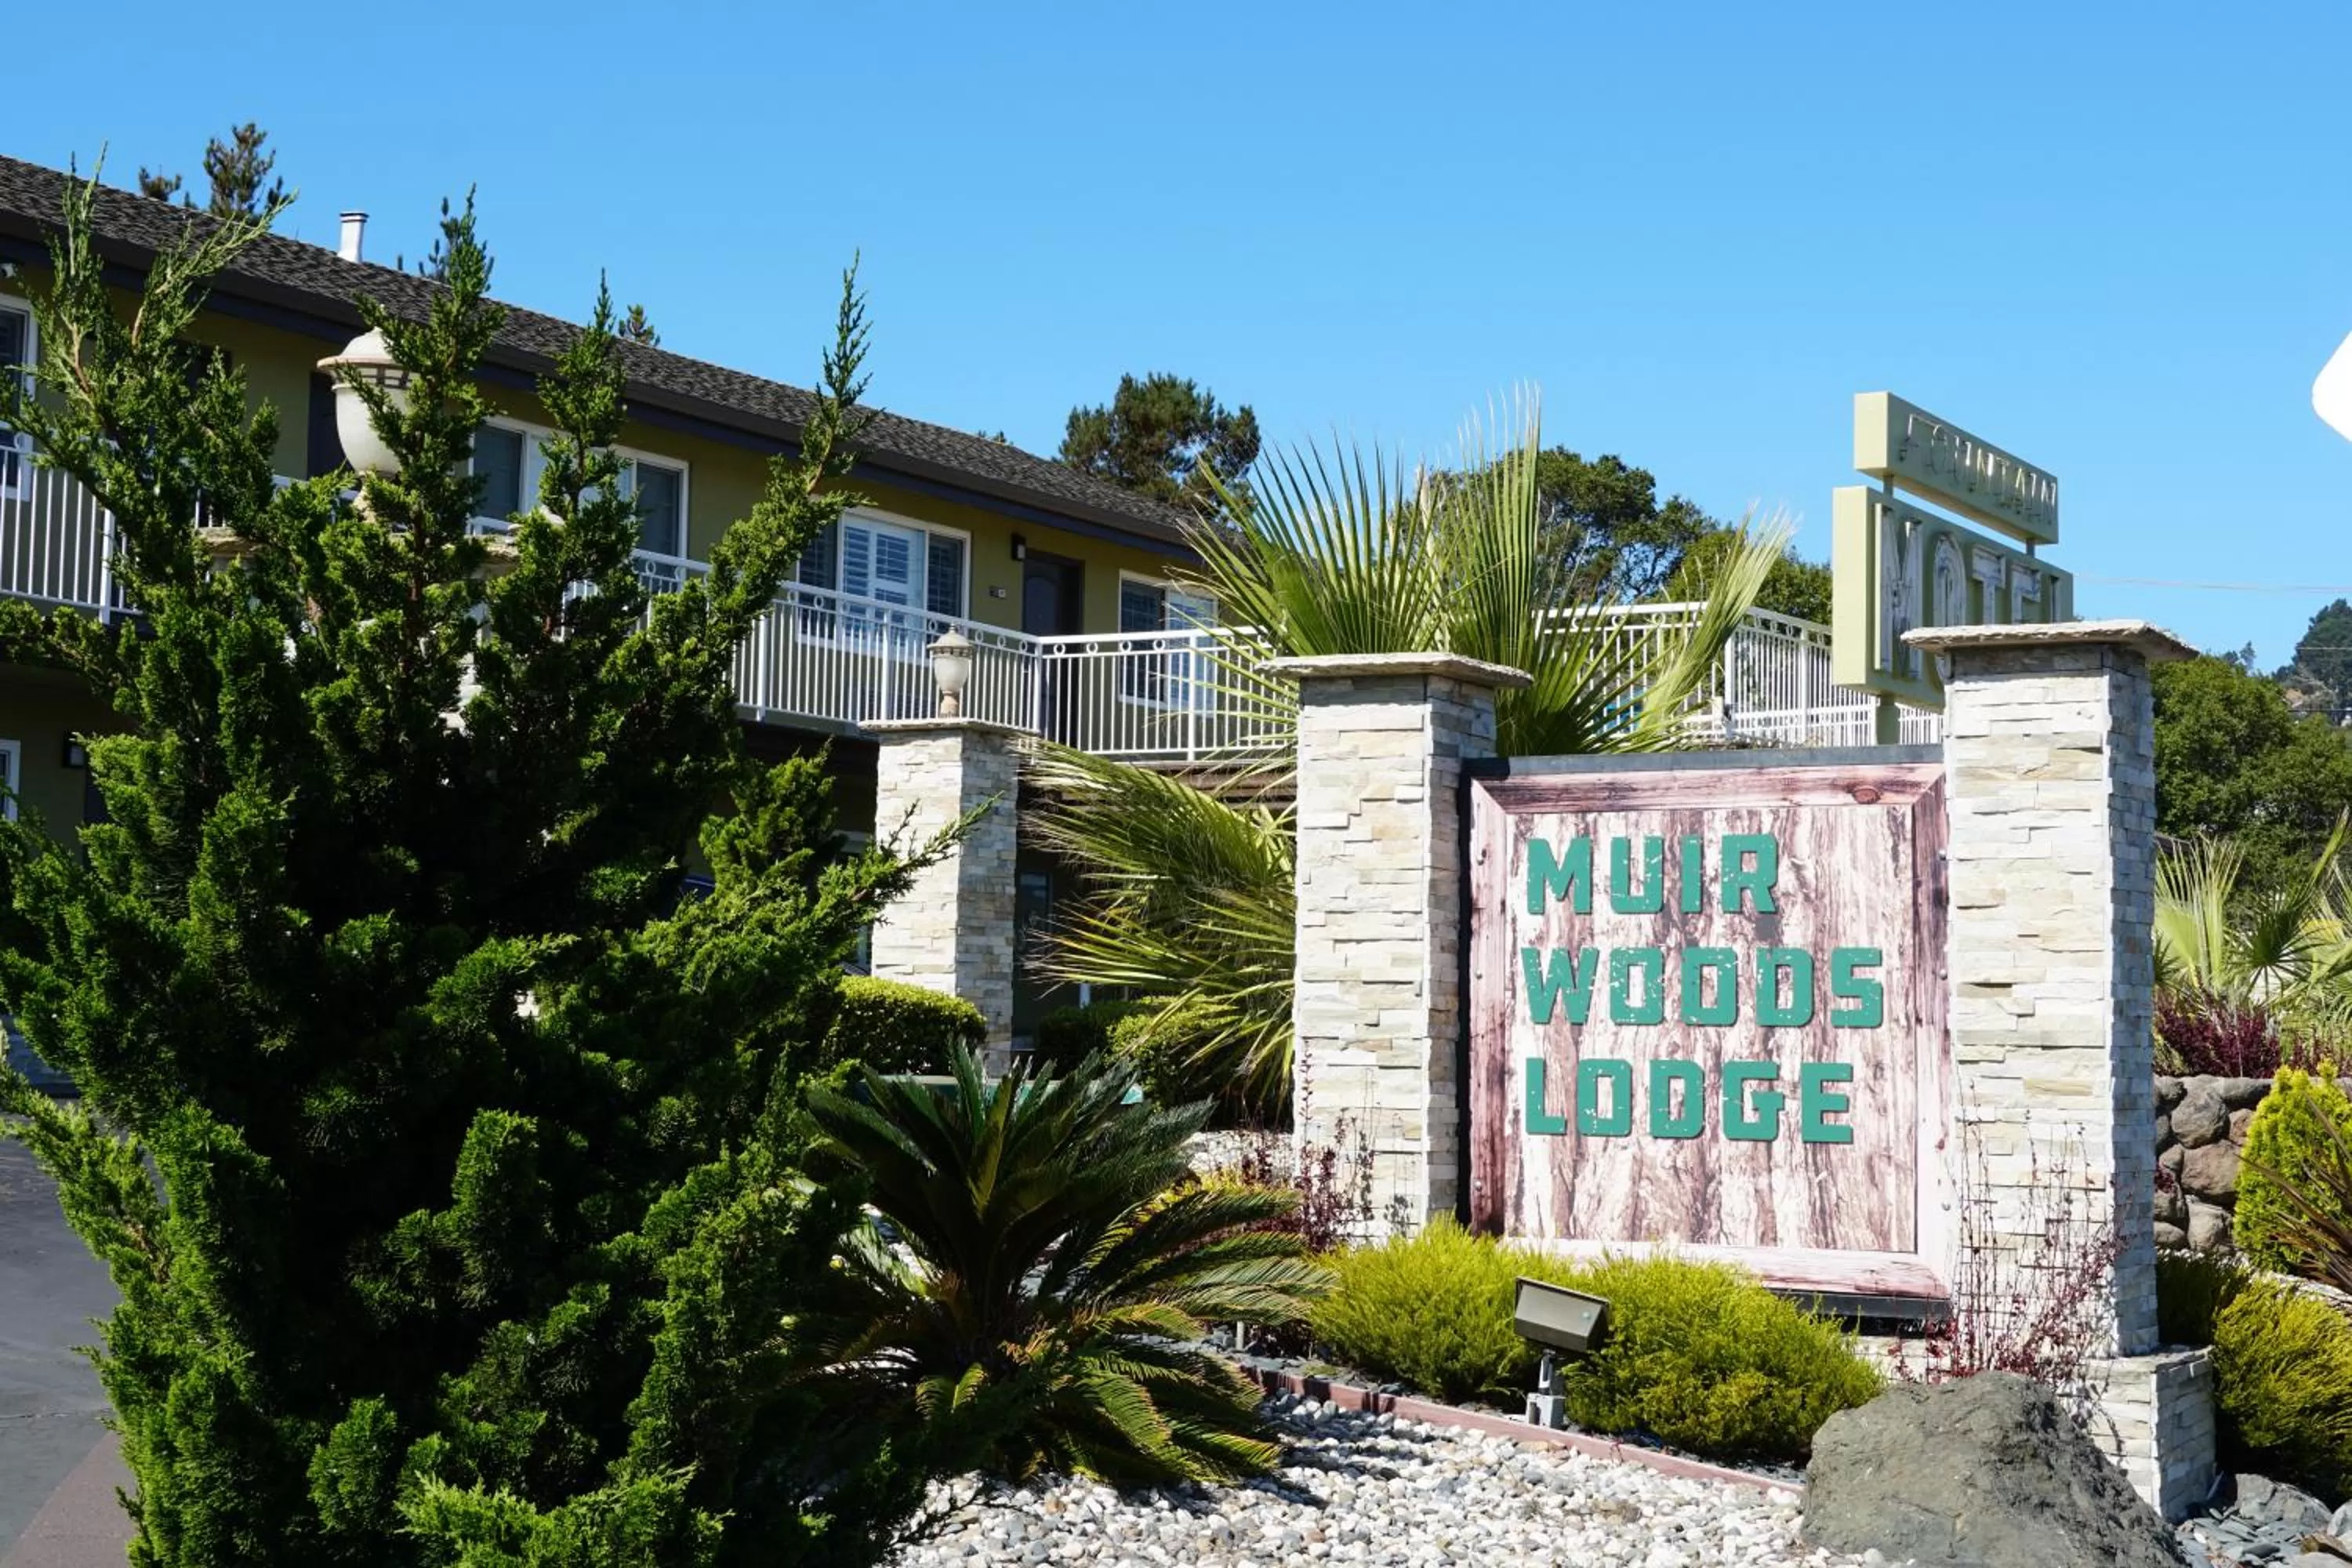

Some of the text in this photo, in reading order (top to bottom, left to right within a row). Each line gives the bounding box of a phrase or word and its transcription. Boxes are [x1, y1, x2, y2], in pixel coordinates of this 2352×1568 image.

[1526, 833, 1777, 914] MUIR
[1521, 947, 1883, 1027] WOODS
[1525, 1057, 1853, 1143] LODGE
